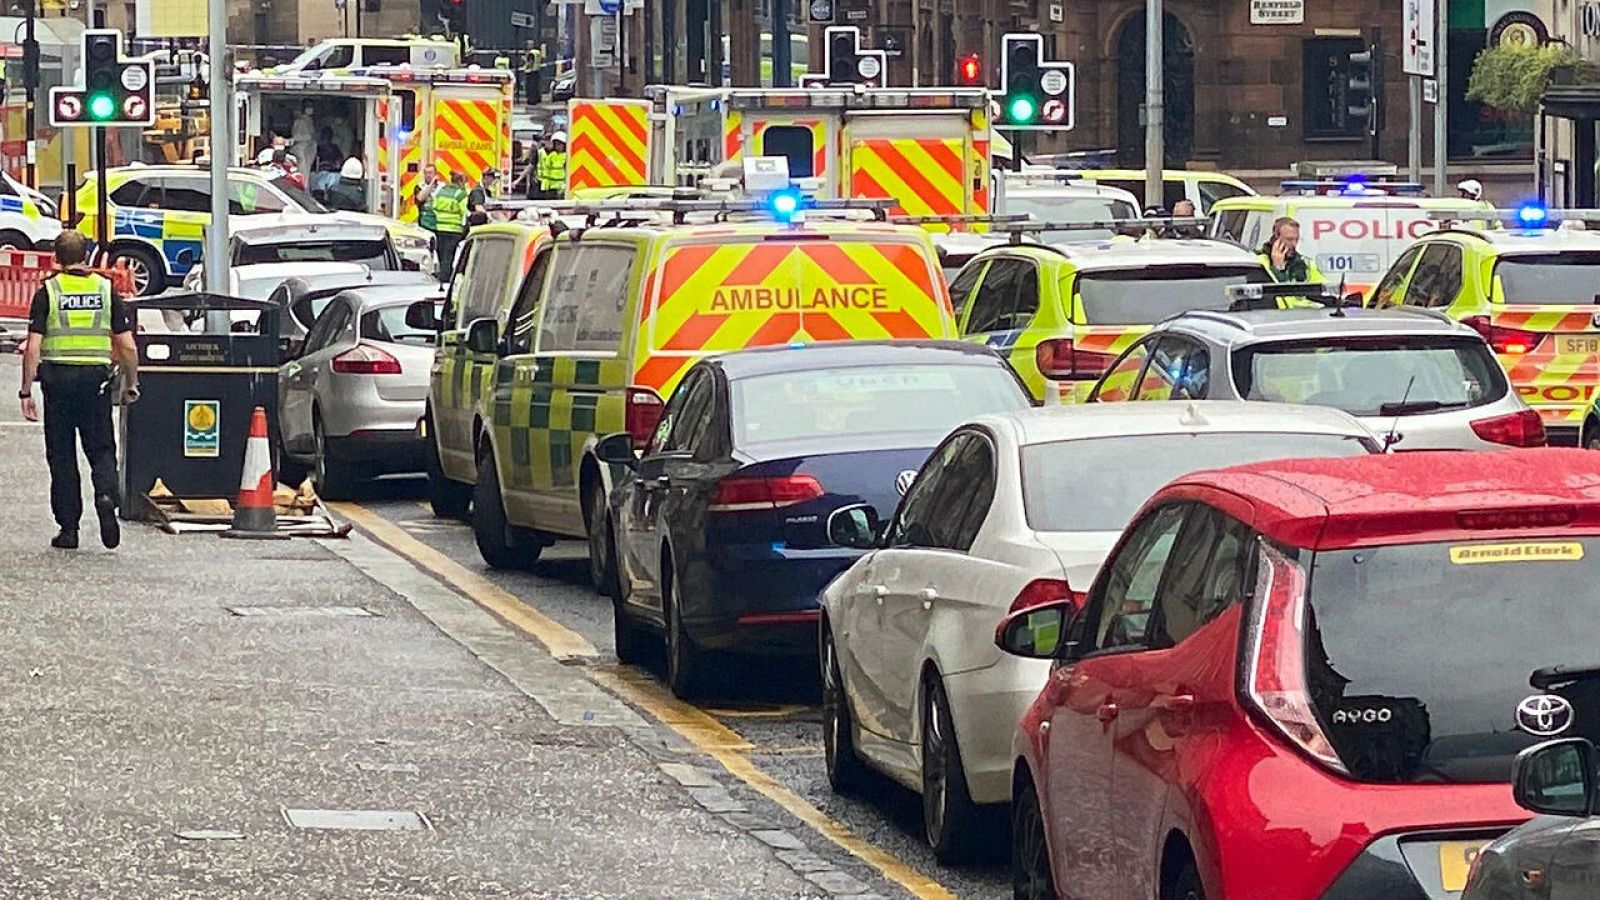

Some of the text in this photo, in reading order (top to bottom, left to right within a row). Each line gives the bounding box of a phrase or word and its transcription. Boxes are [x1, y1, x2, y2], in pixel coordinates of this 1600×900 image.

[1253, 1, 1302, 10] RENFIELD
[1258, 10, 1296, 18] STREET
[1313, 219, 1435, 241] POLIC
[1328, 256, 1354, 270] 101
[59, 294, 102, 310] POLICE
[710, 286, 889, 311] AMBULANCE
[1458, 544, 1574, 559] Arnold Clark
[1332, 707, 1392, 724] AYGO
